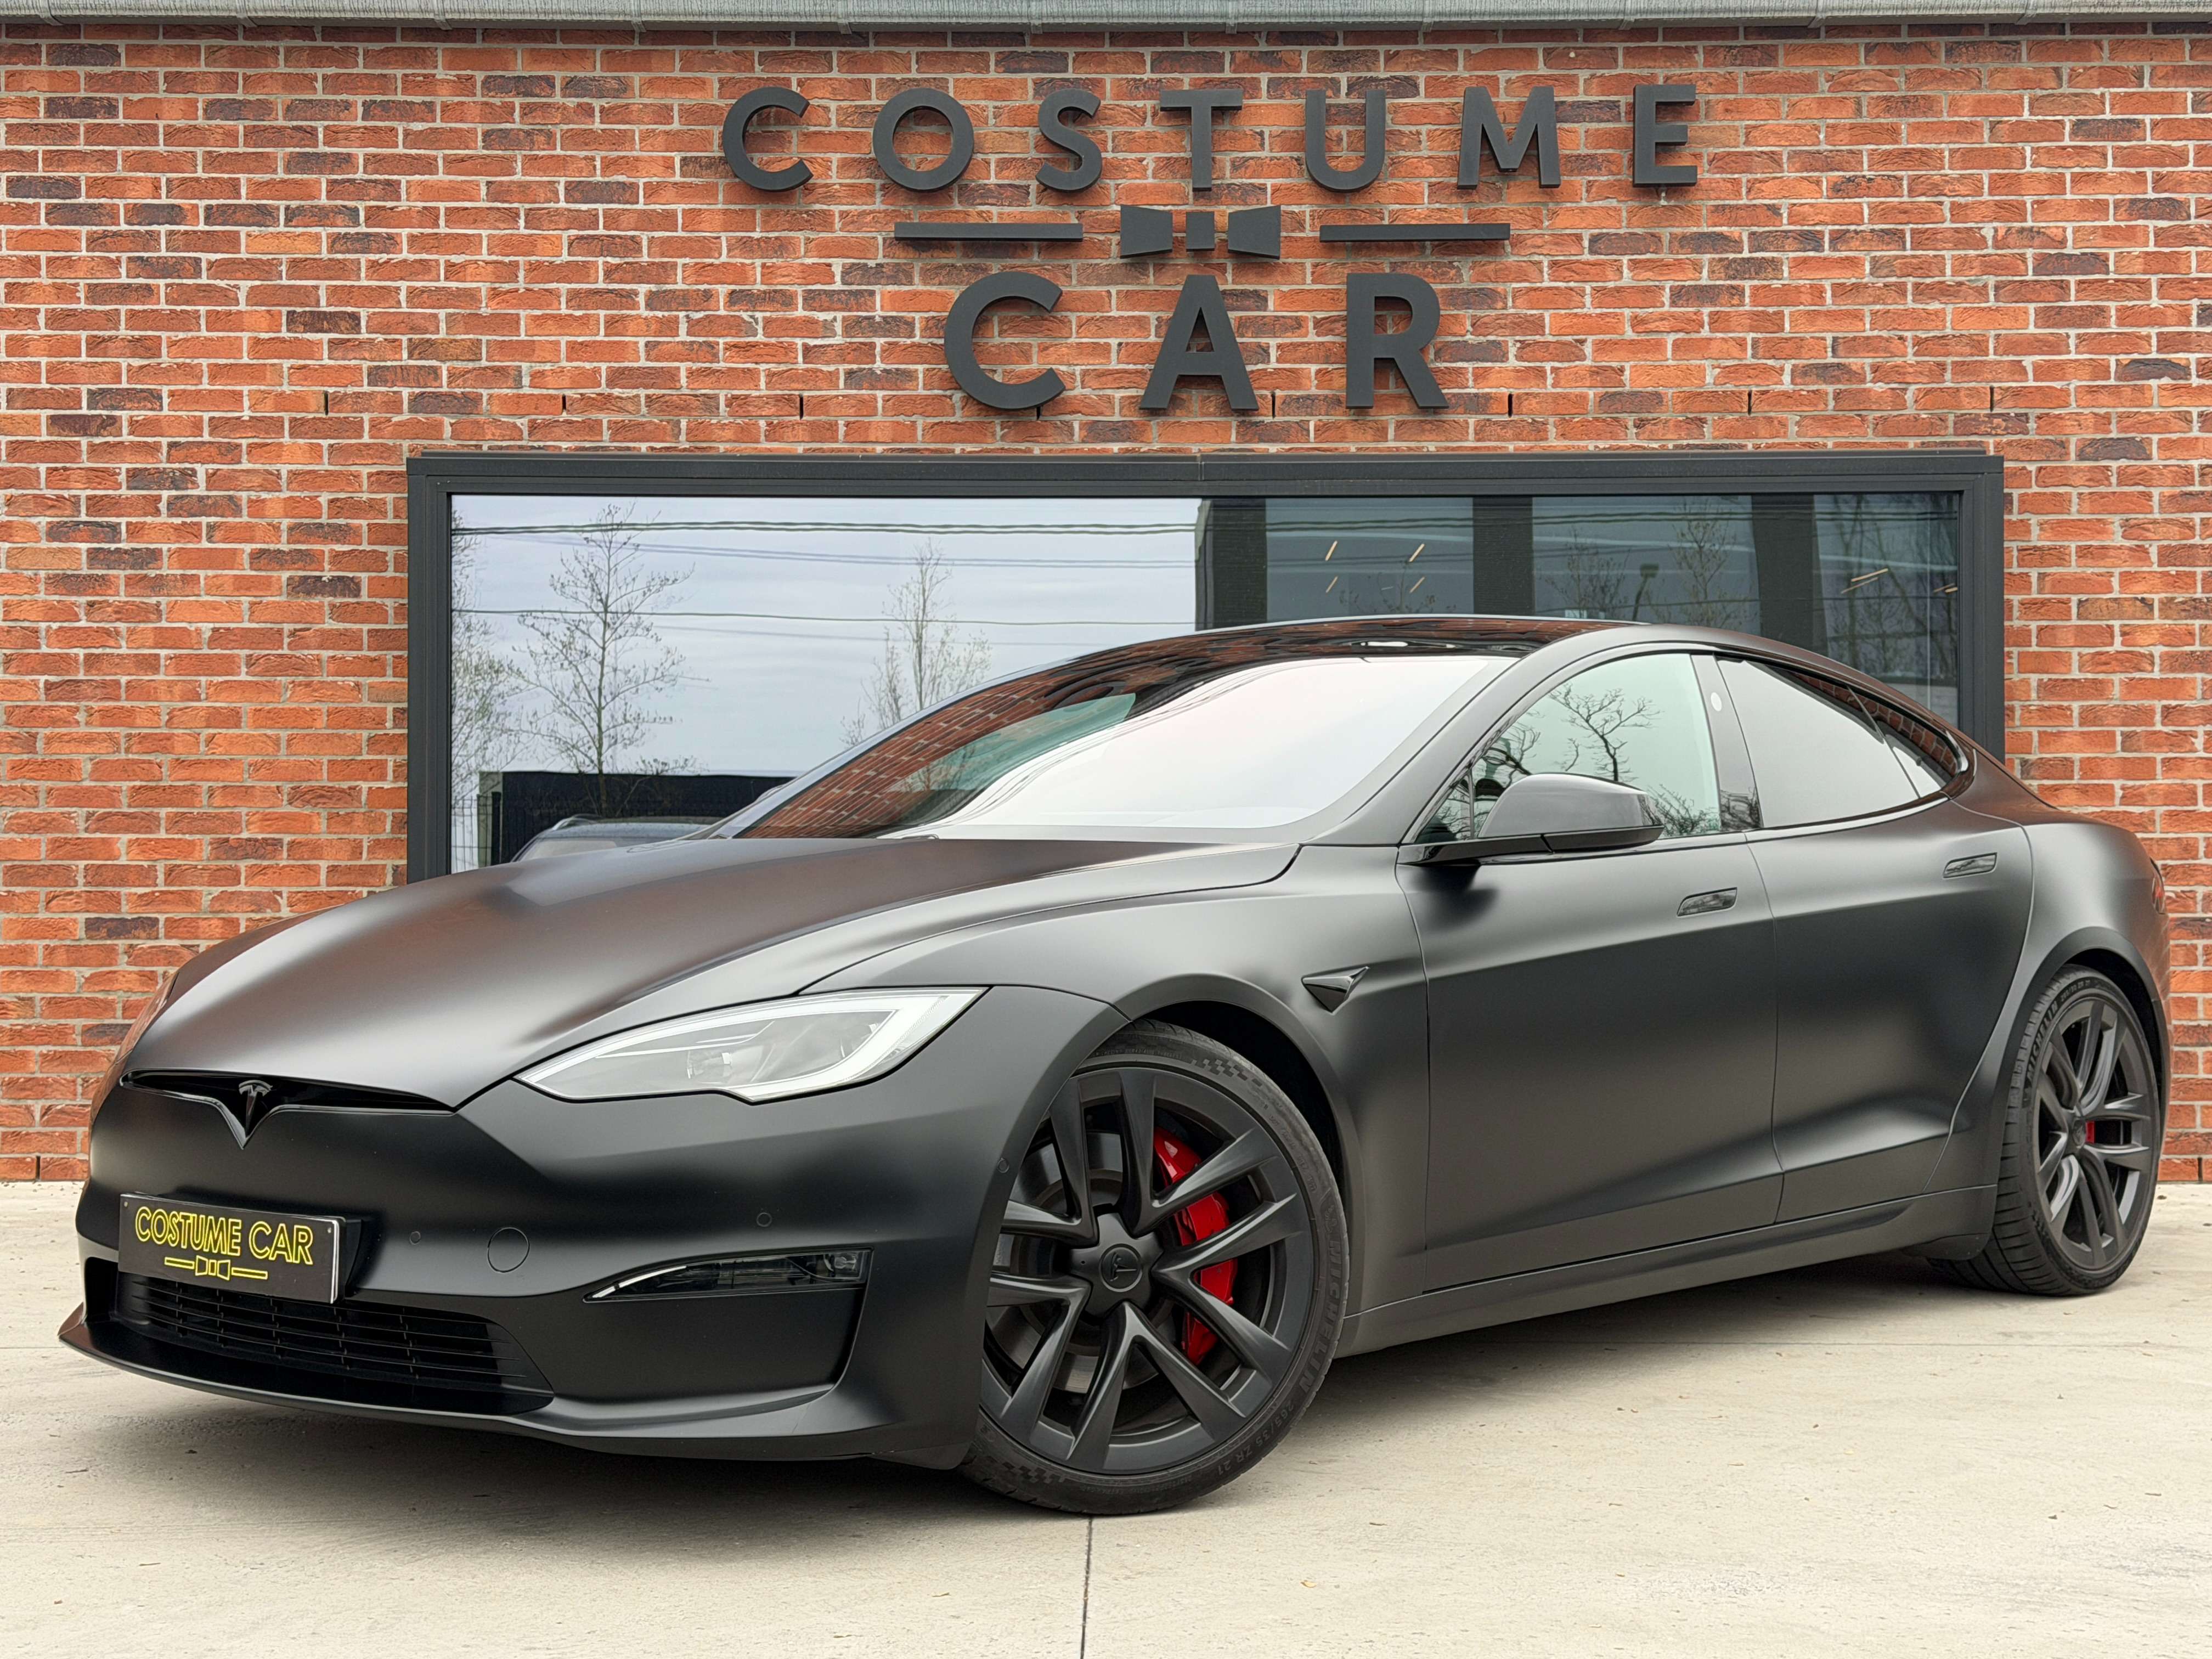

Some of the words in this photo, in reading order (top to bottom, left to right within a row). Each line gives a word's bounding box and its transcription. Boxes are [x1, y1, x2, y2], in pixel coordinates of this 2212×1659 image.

[721, 85, 1697, 191] COSTUME
[944, 274, 1448, 410] CAR
[2027, 1001, 2058, 1084] MICHELIN
[135, 1206, 242, 1256] COSTUME
[249, 1221, 313, 1265] CAR
[1299, 1240, 1342, 1393] MICHELIN
[1235, 1444, 1253, 1463] ZR
[1255, 1401, 1294, 1447] 265/35
[1217, 1459, 1232, 1475] 21
